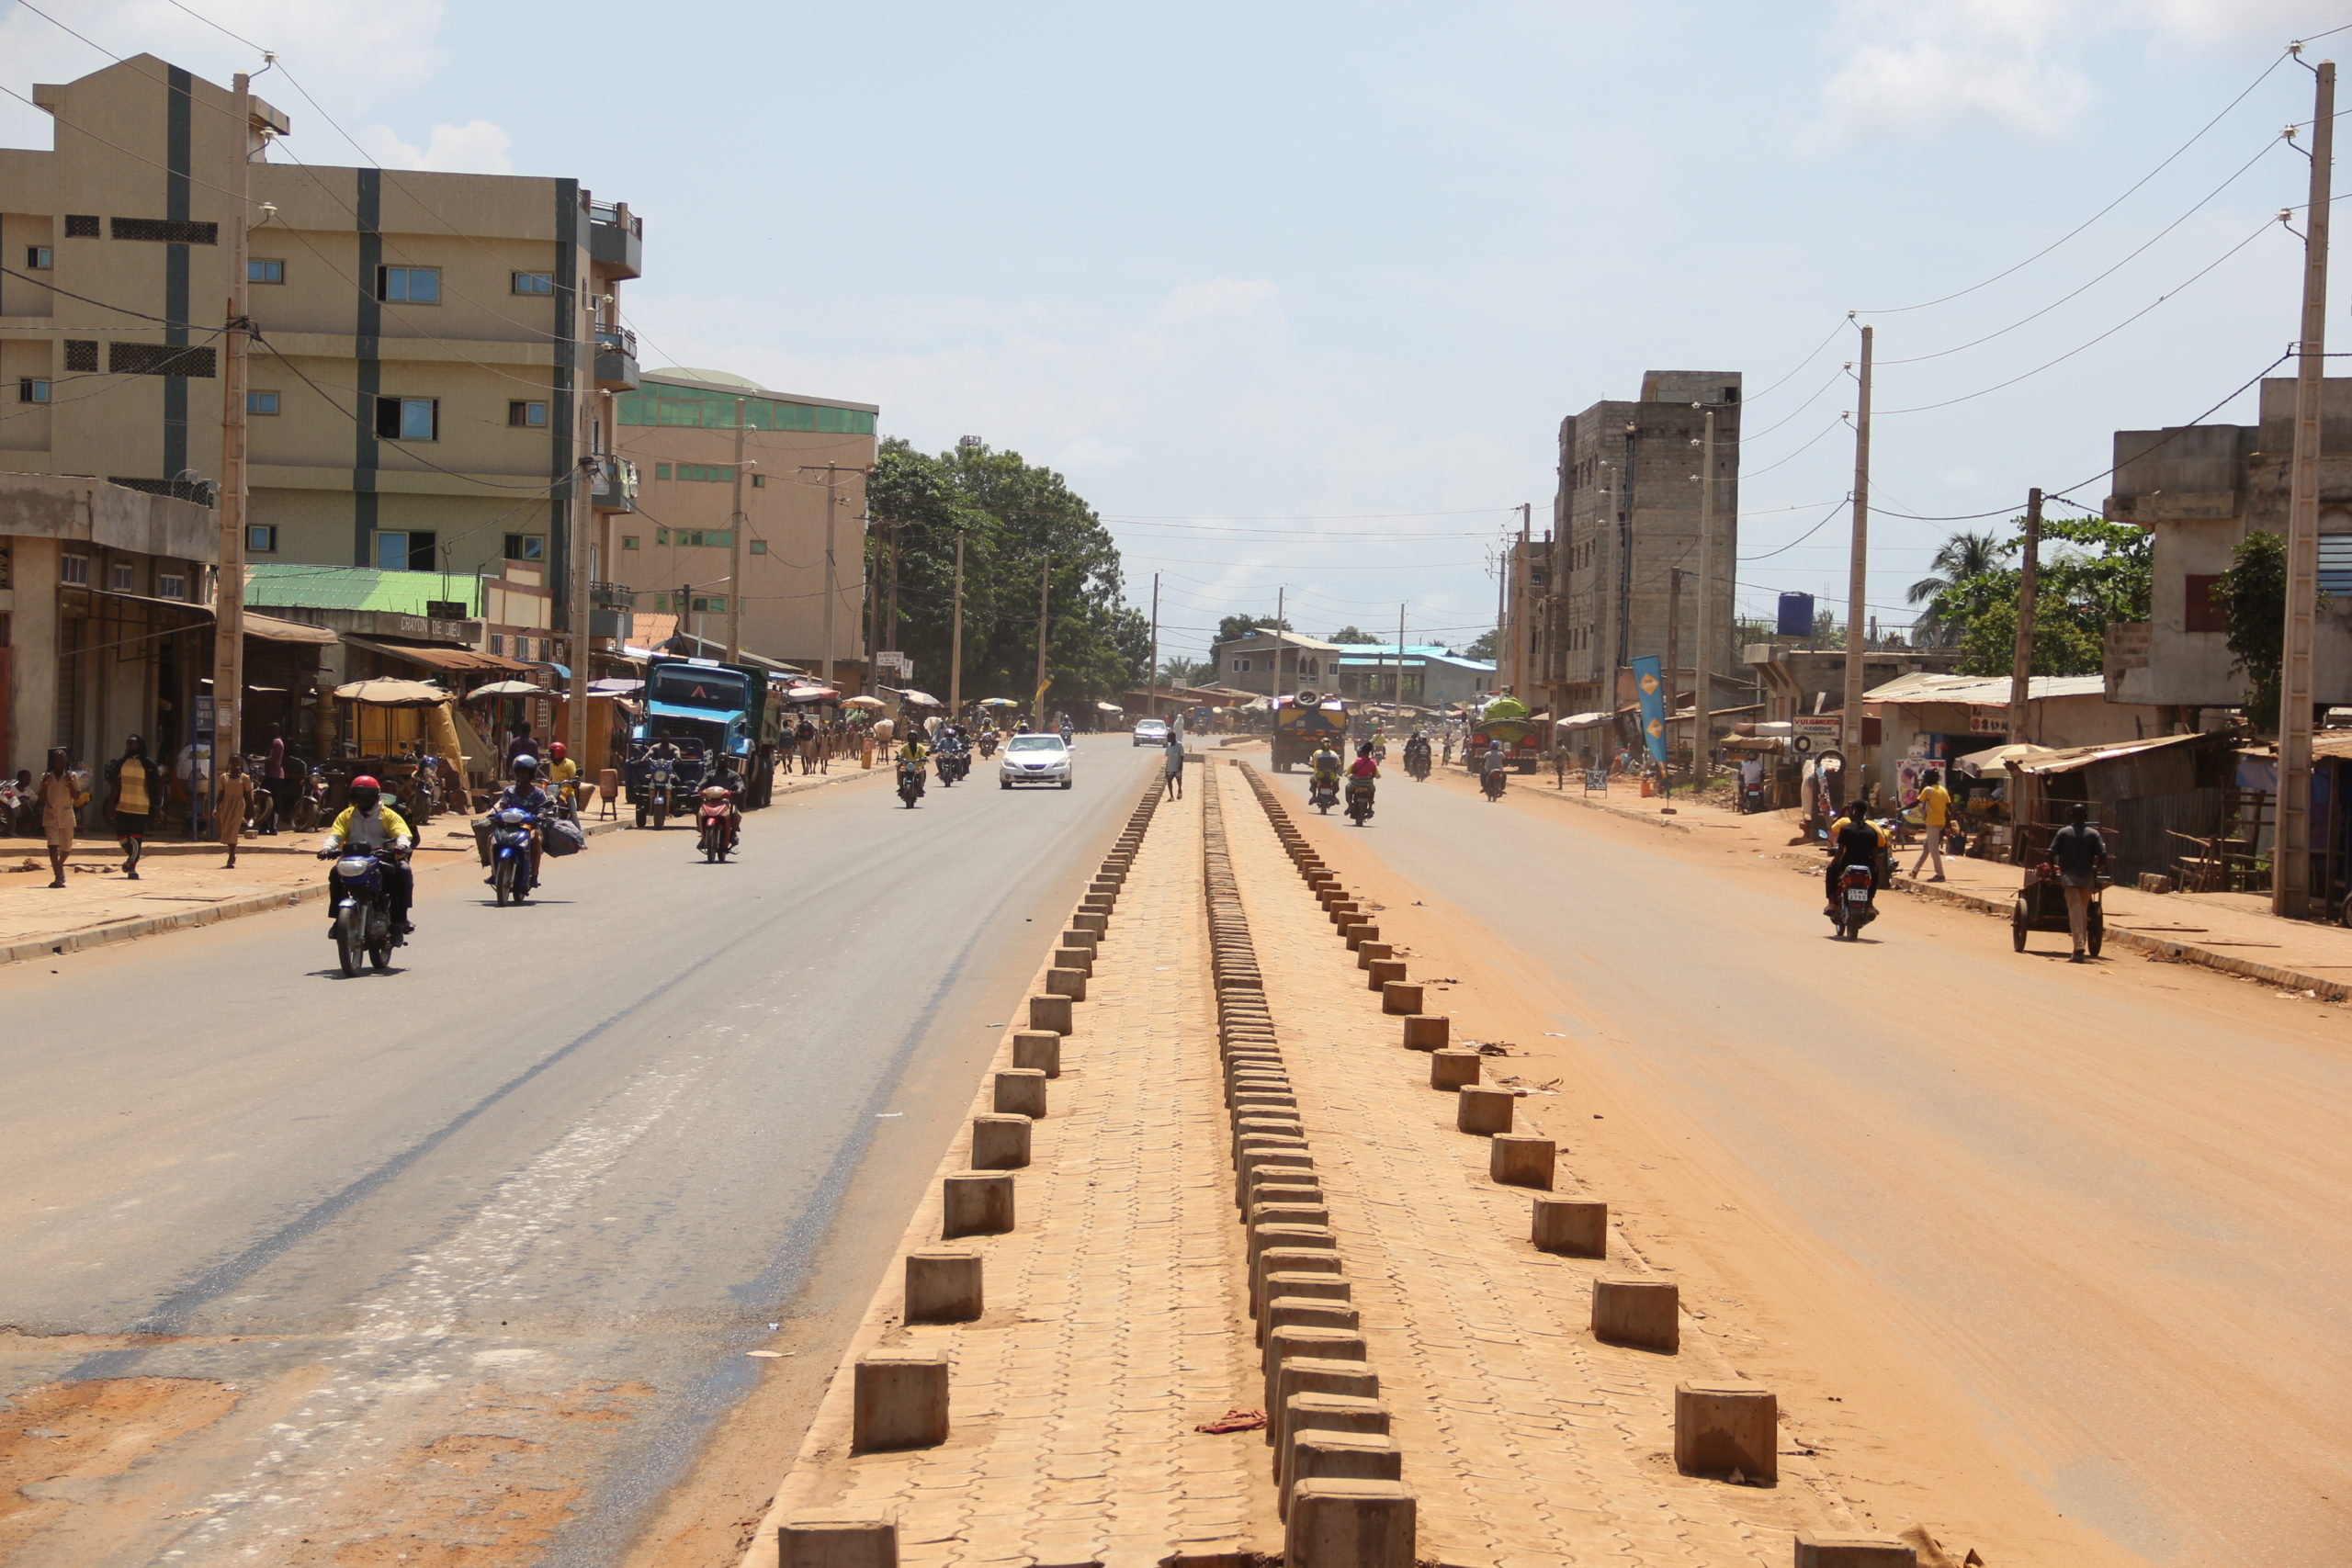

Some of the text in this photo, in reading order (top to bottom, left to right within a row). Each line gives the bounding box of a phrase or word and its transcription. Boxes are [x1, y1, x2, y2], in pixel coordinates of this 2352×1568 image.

[401, 616, 461, 637] CRAYON DE DIEU
